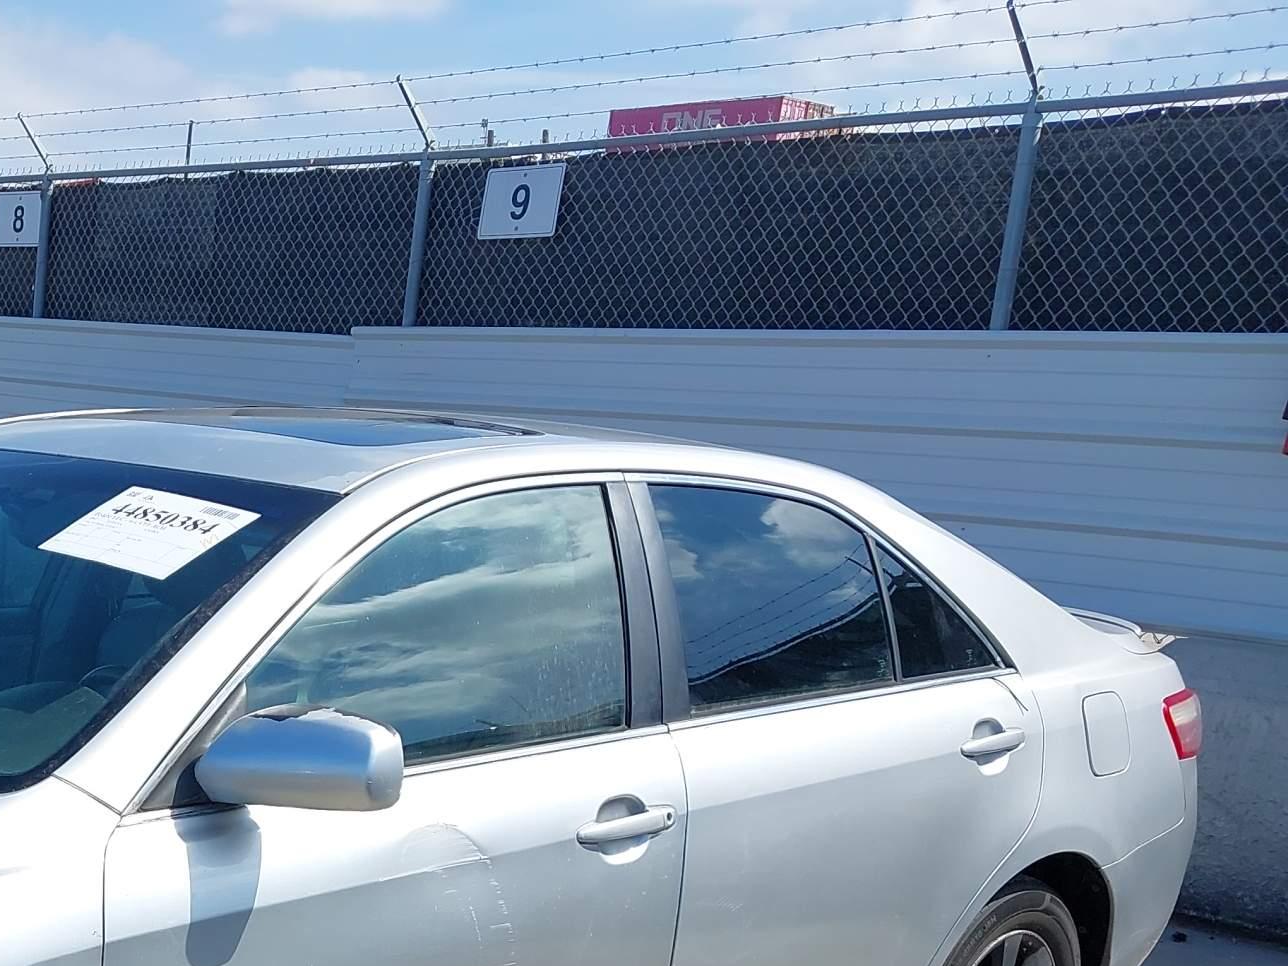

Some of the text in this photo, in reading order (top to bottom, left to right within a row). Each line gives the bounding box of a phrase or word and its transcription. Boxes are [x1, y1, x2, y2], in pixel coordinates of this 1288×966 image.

[510, 184, 531, 221] 9
[13, 205, 25, 233] 8
[111, 503, 221, 535] 44850384
